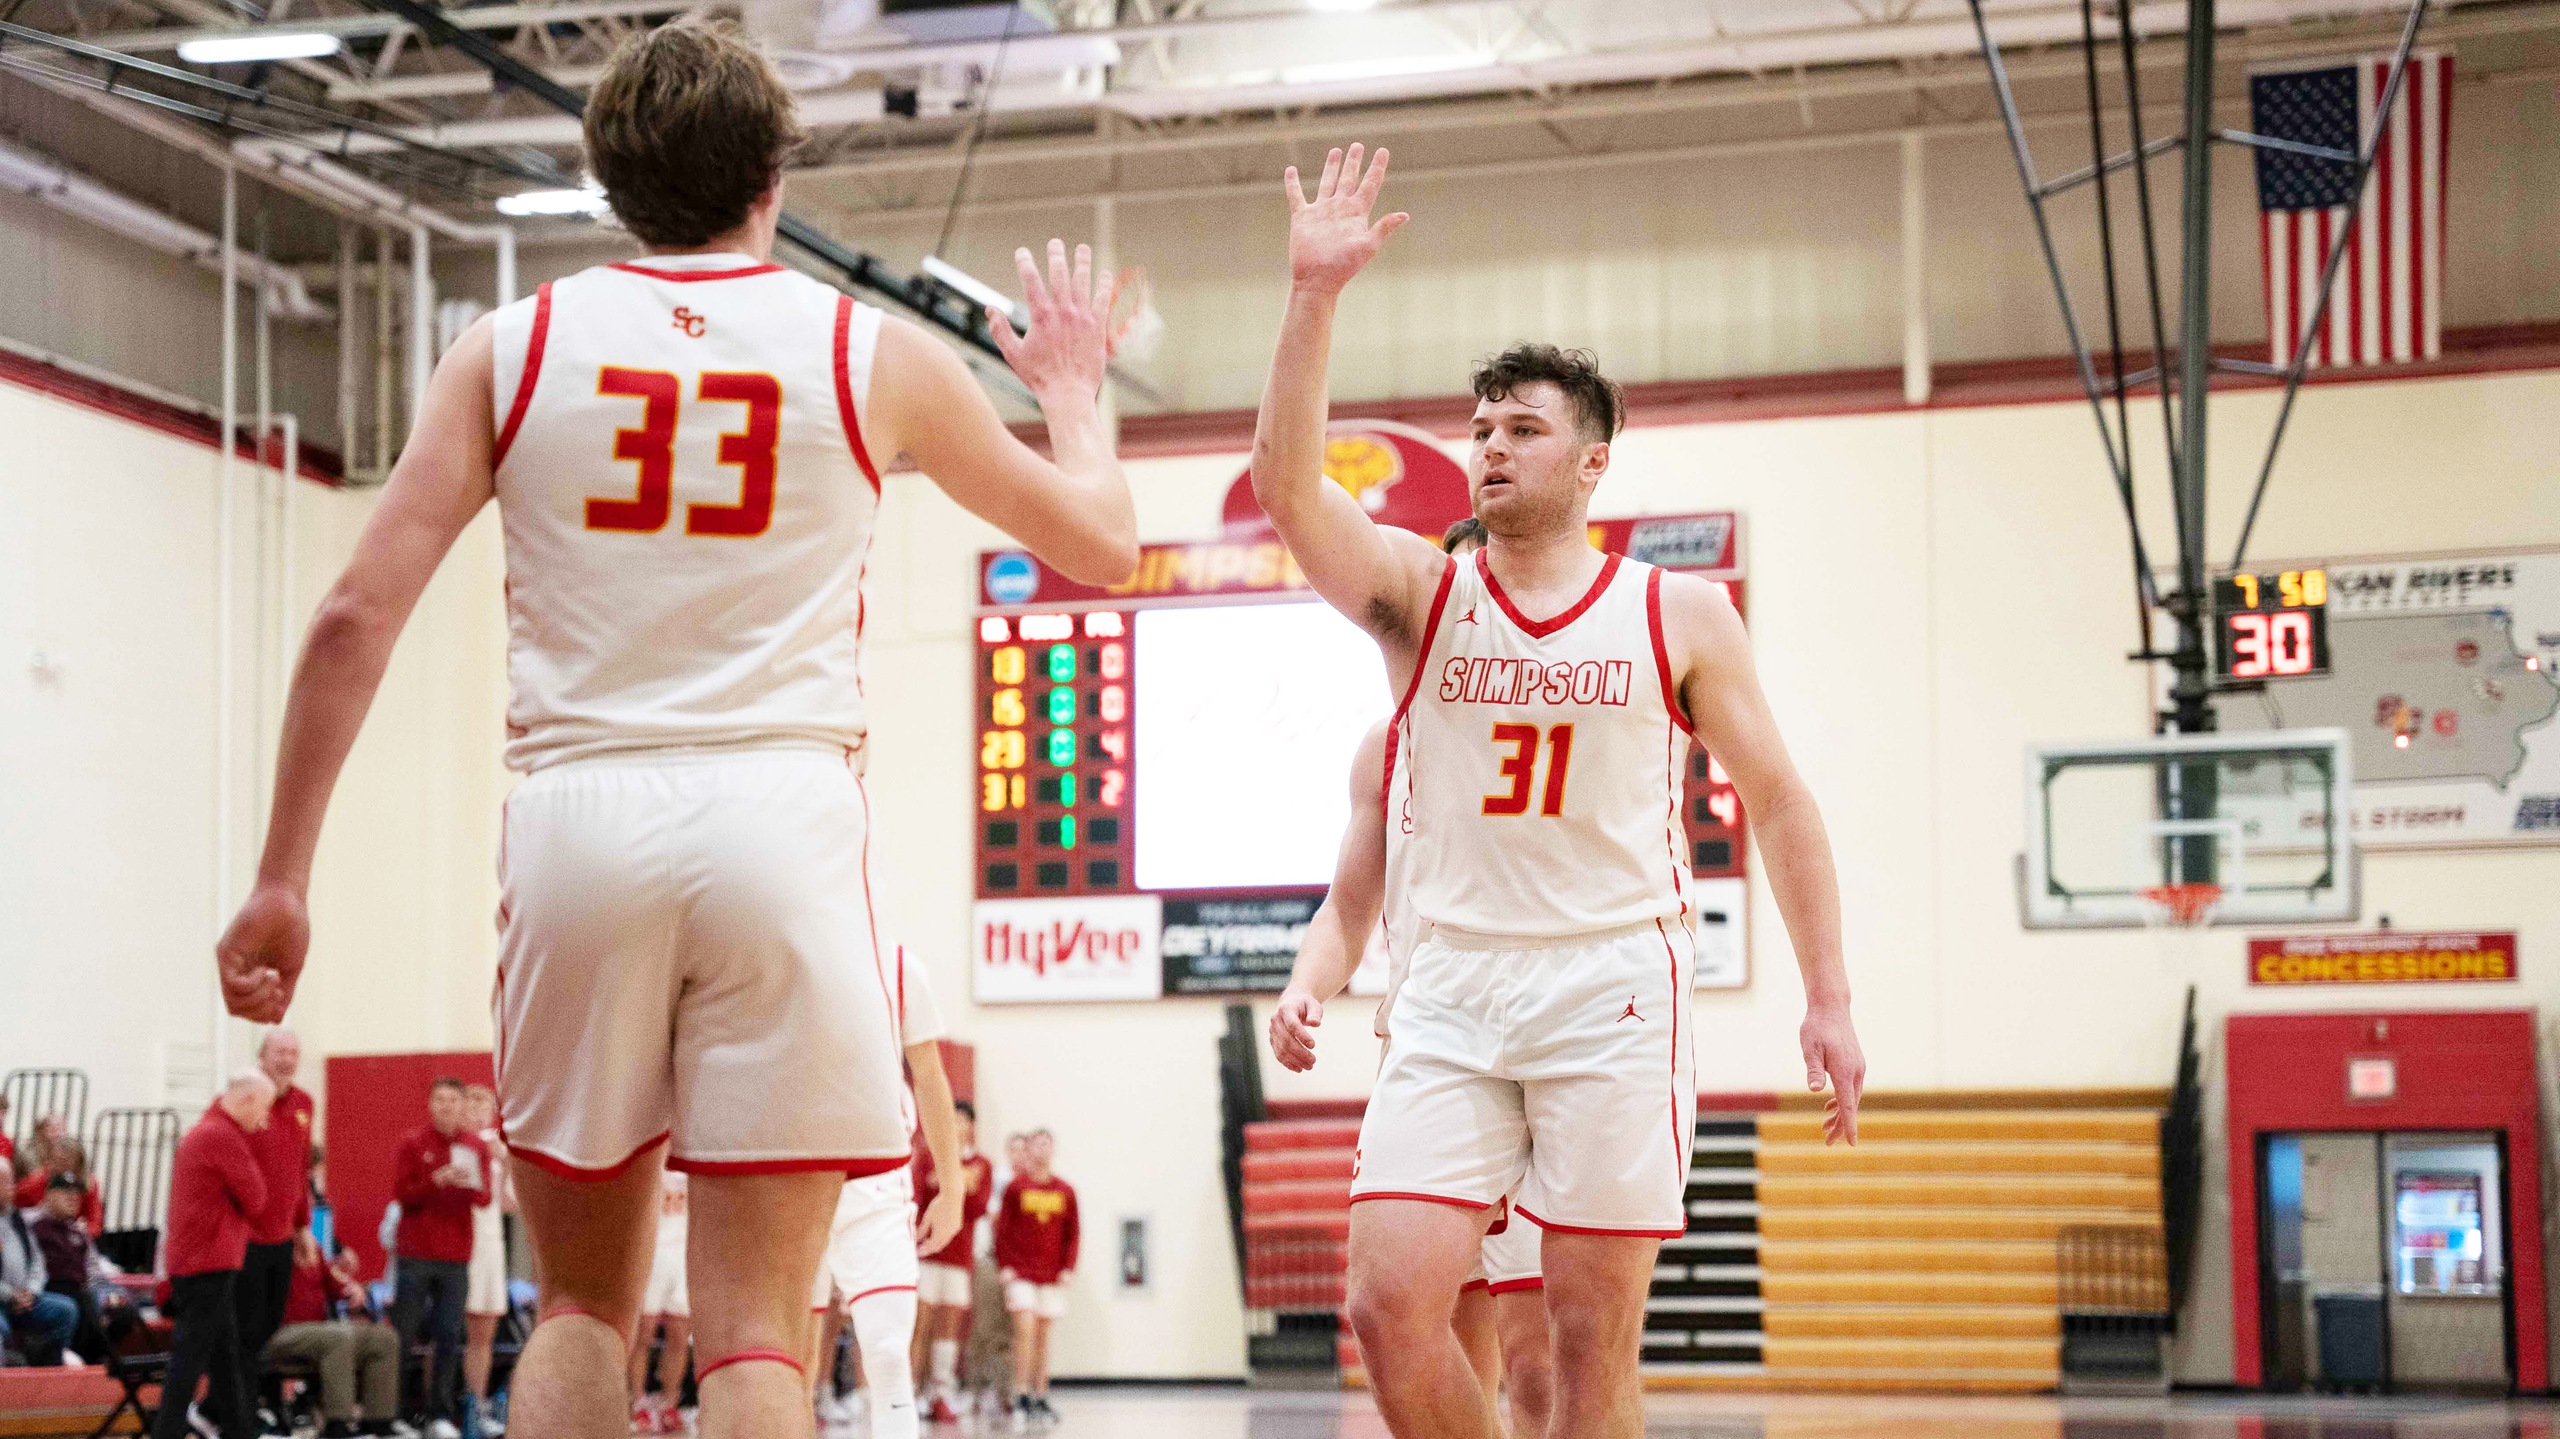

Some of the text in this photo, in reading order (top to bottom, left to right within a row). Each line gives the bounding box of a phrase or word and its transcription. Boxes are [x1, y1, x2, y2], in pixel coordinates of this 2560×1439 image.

[672, 306, 705, 339] SC
[584, 365, 783, 537] 33
[2229, 611, 2312, 677] 30
[1439, 656, 1632, 706] SIMPSON
[983, 769, 1126, 812] 31 1 2
[1481, 721, 1574, 818] 31
[1708, 790, 1737, 828] 4
[1060, 814, 1076, 850] 1
[2256, 951, 2507, 981] CONCESSIONS
